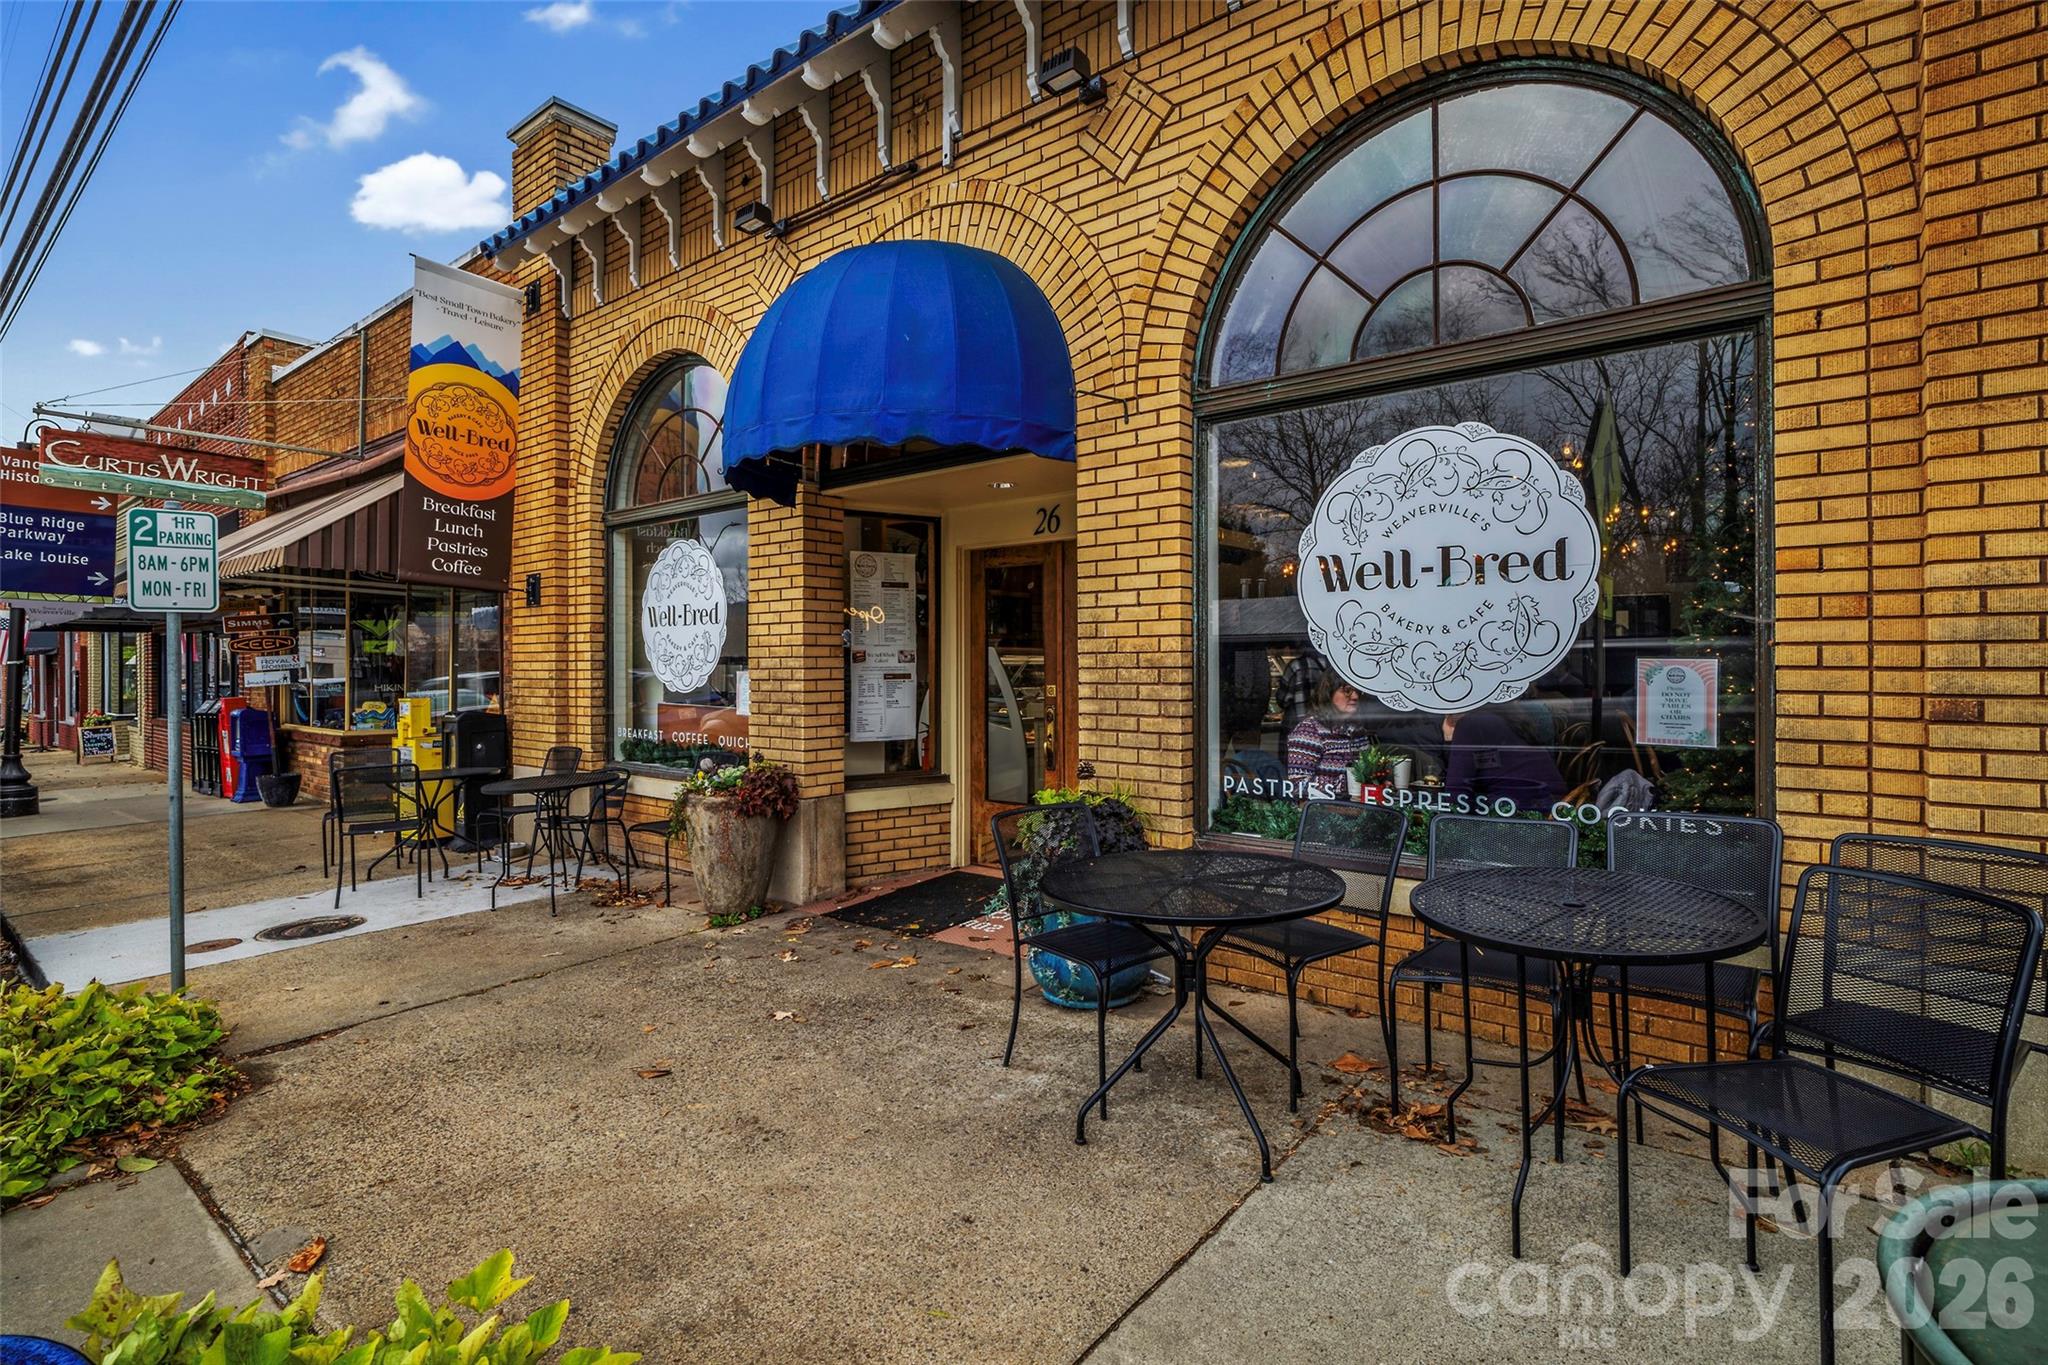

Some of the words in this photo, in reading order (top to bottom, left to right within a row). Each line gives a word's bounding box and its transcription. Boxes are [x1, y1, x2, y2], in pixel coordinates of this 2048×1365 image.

[440, 297, 464, 310] Small
[465, 303, 489, 318] Town
[441, 305, 468, 321] Travel
[474, 315, 504, 332] Leisure
[416, 418, 510, 453] Well-Bred
[423, 497, 496, 521] Breakfast
[0, 512, 34, 526] Blue
[41, 516, 85, 532] Ridge
[134, 515, 153, 541] 2
[174, 516, 196, 530] HR
[435, 518, 483, 538] Lunch
[1033, 503, 1061, 536] 26
[1381, 503, 1492, 540] WEAVERVILLE'S
[0, 526, 66, 544] Parkway
[159, 531, 211, 546] PARKING
[427, 536, 488, 558] Pastries
[0, 549, 33, 561] ake
[40, 551, 89, 566] Louise
[138, 554, 168, 571] 8AM
[180, 557, 209, 573] 6PM
[431, 557, 482, 576] Coffee
[1316, 536, 1575, 593] Well-Bred
[142, 580, 171, 597] MON
[184, 582, 206, 598] FRI
[227, 619, 270, 628] SIMMS
[647, 602, 721, 628] Well-Bred
[1380, 603, 1434, 635] BAKERY
[1441, 624, 1452, 635] &
[1457, 599, 1494, 630] CAFE
[233, 639, 291, 649] KEEN
[617, 727, 664, 742] BREAKFAST
[671, 731, 709, 745] COFFEE
[1224, 775, 1336, 800] PASTRIES
[1364, 785, 1517, 818] ESPRESSO
[1551, 801, 1723, 836] COOKIES
